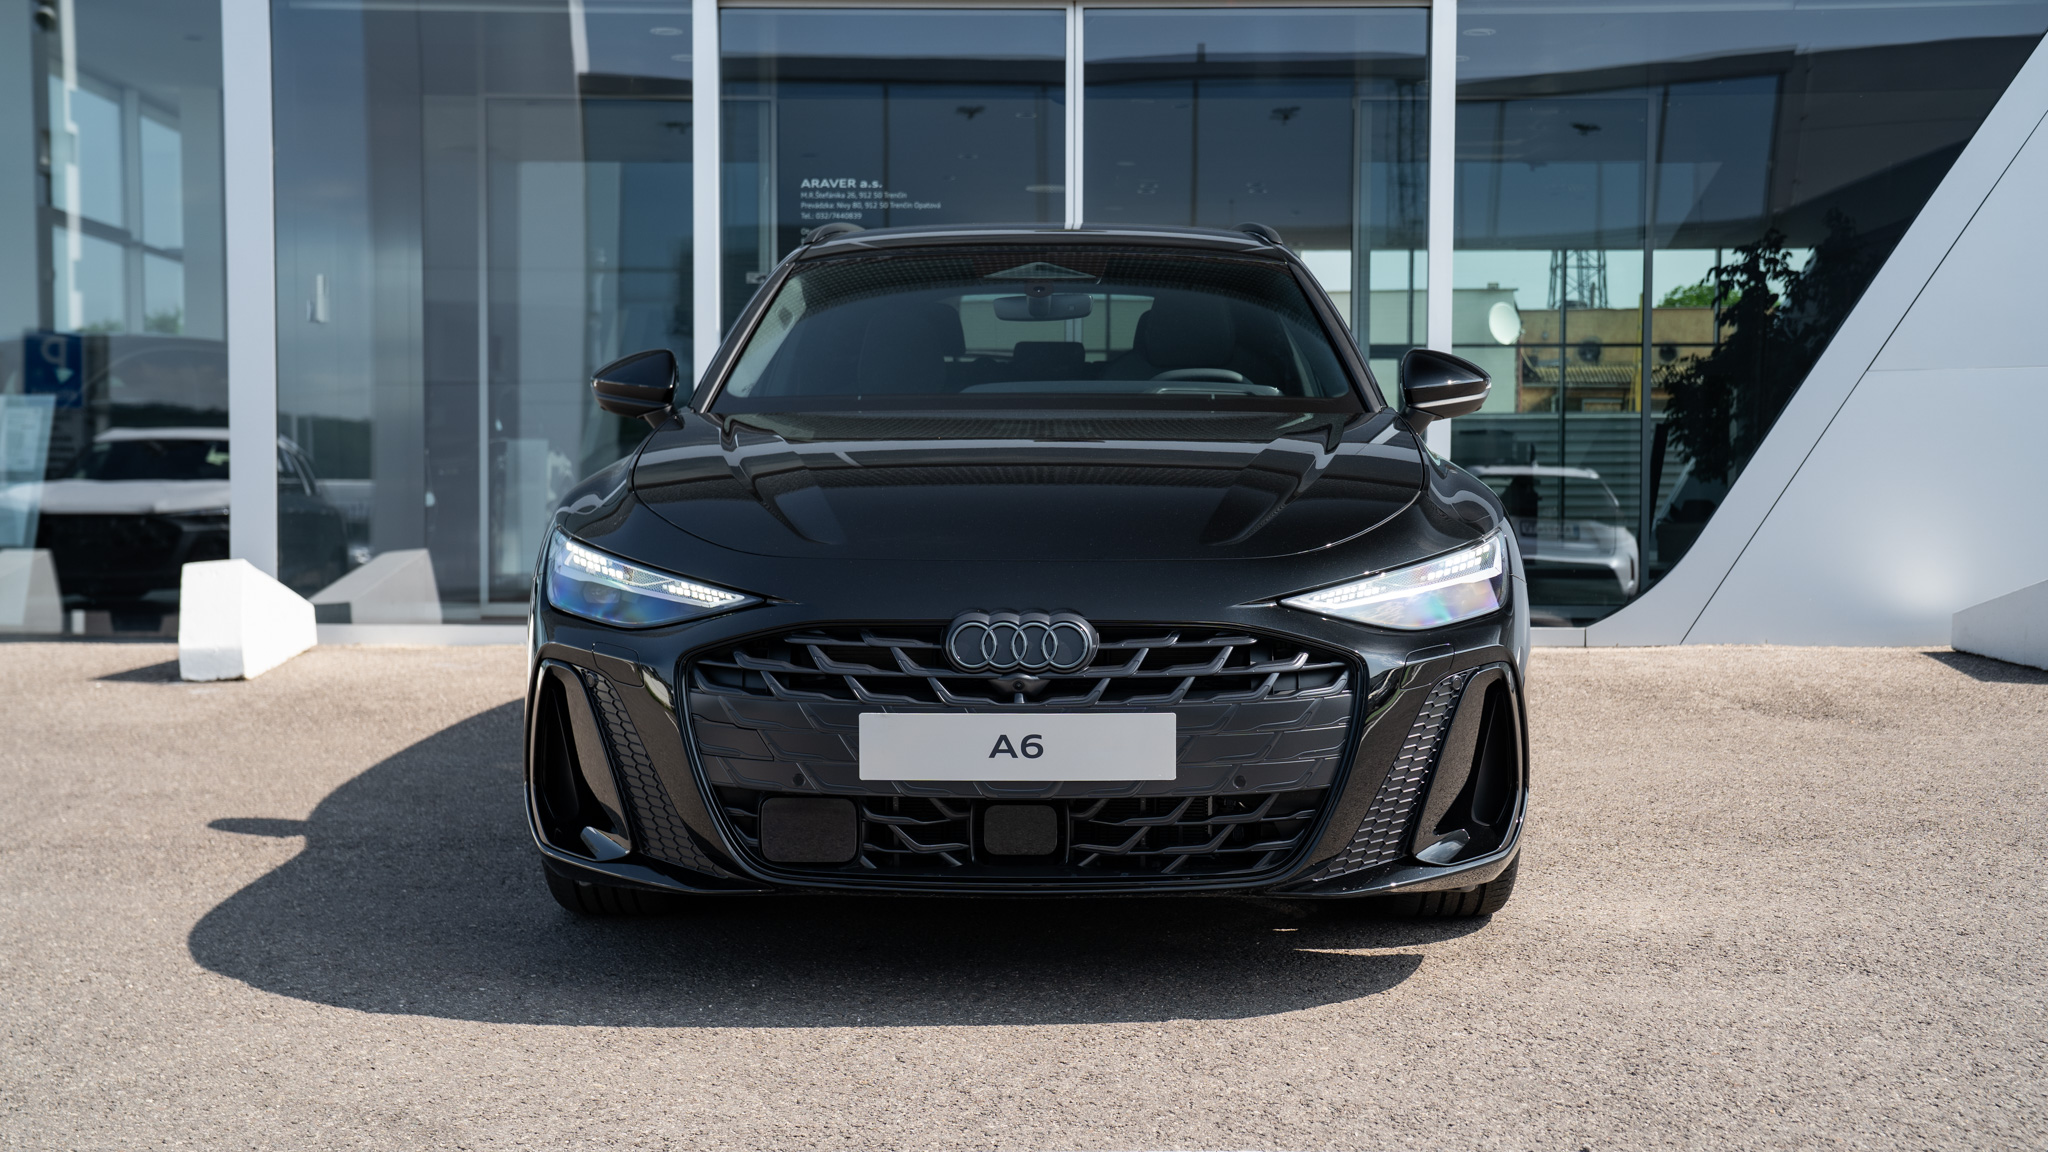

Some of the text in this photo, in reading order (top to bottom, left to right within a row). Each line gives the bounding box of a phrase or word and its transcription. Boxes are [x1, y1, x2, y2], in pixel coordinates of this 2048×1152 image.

[801, 178, 883, 189] ARAVER a.s.
[859, 191, 872, 199] 912
[865, 201, 877, 209] 912
[988, 734, 1044, 759] A6
